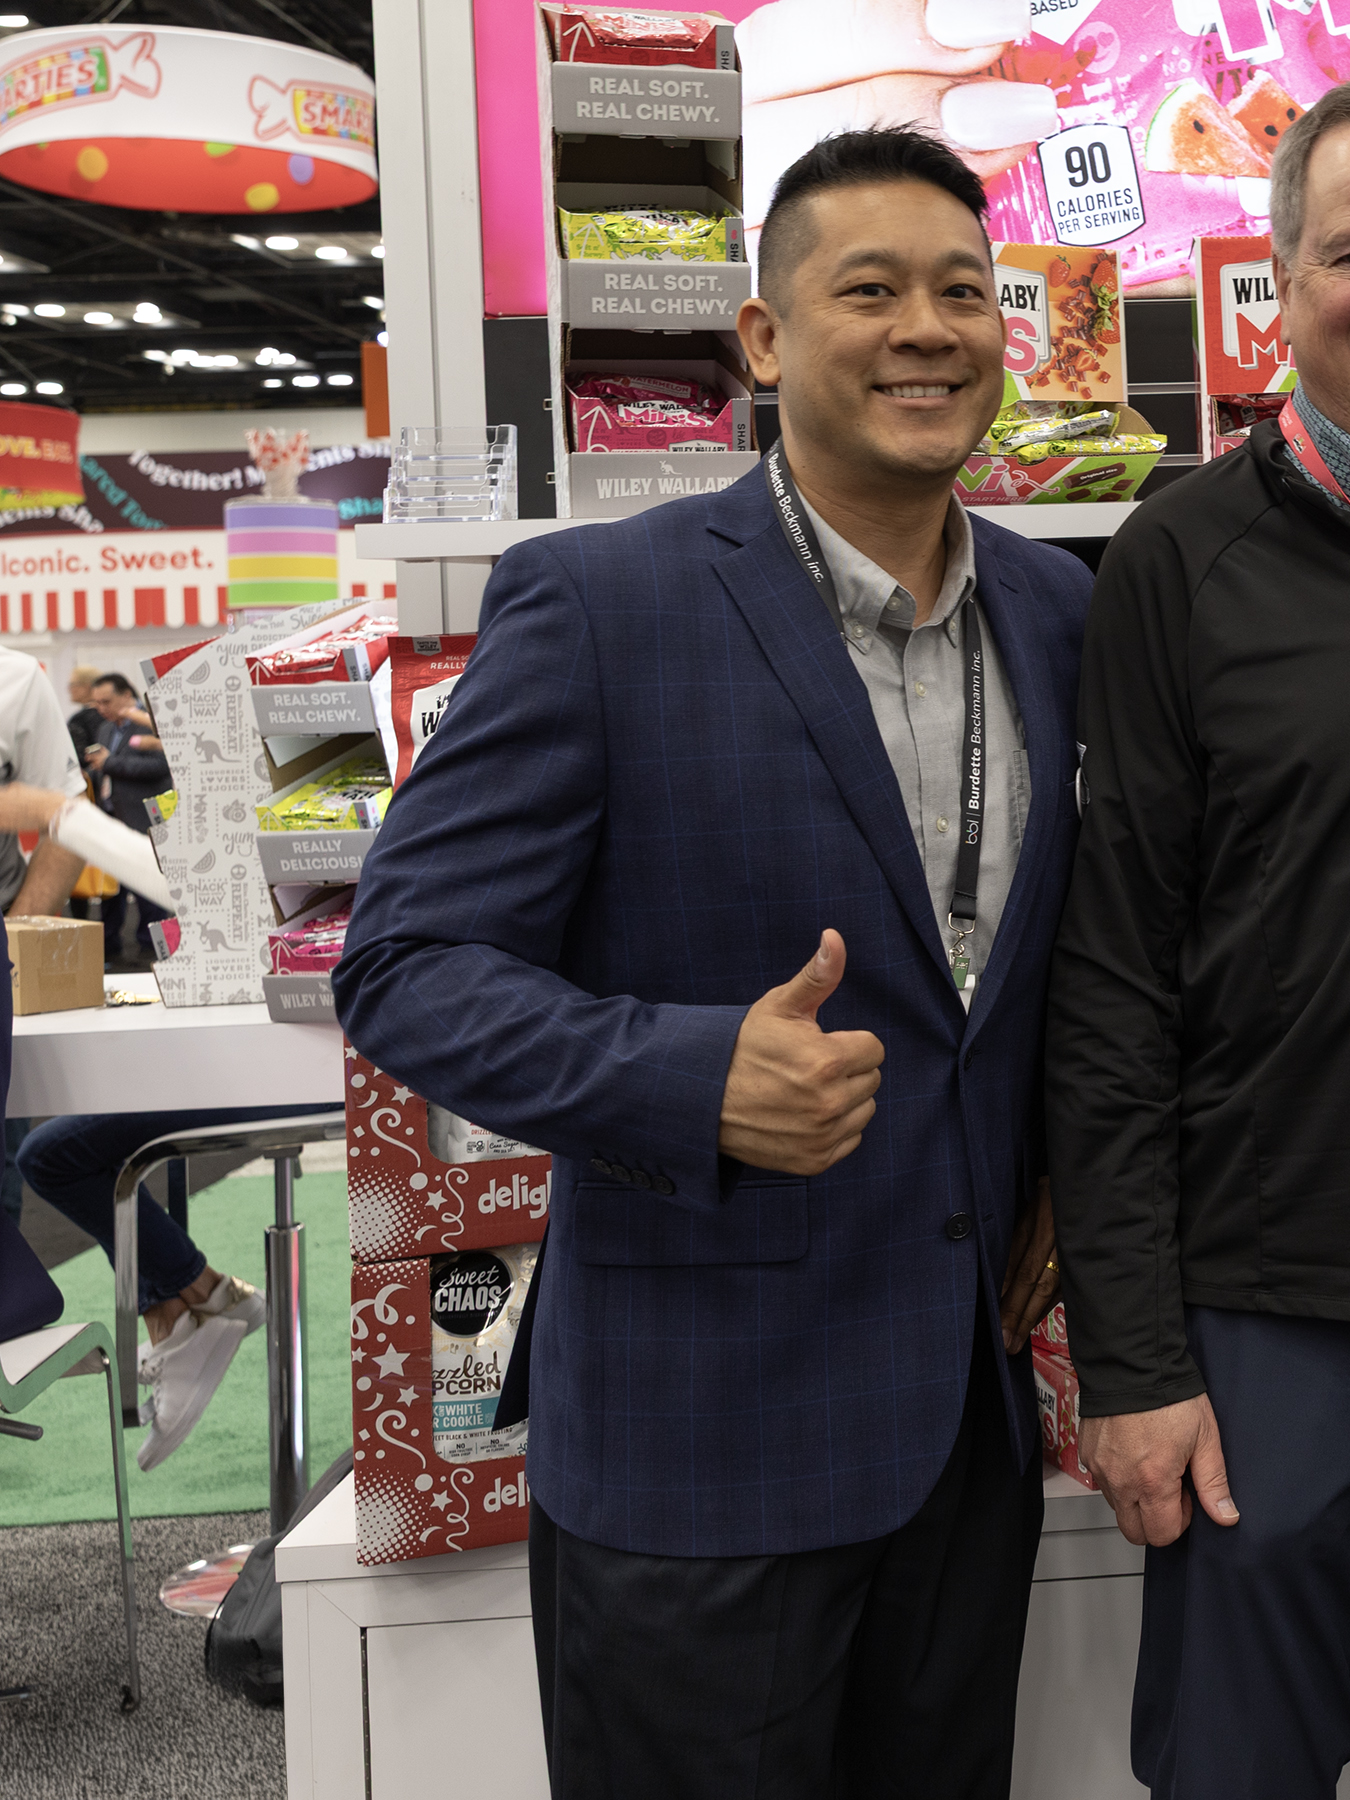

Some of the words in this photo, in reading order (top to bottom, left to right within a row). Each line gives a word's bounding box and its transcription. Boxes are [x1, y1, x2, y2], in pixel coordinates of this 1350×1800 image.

[0, 59, 97, 112] ARTIES
[589, 77, 645, 96] REAL
[649, 80, 710, 99] SOFT.
[577, 101, 632, 120] REAL
[636, 103, 720, 123] CHEWY.
[1064, 141, 1112, 188] 90
[1056, 188, 1134, 218] CALORIES
[1058, 217, 1081, 235] PER
[1084, 206, 1141, 231] SERVING
[605, 273, 660, 290] REAL
[663, 274, 724, 292] SOFT.
[592, 297, 647, 314] REAL
[650, 298, 734, 316] CHEWY.
[998, 283, 1039, 312] ABY
[1235, 312, 1294, 369] M
[630, 376, 689, 393] WATERMELON
[1079, 470, 1105, 482] Original
[596, 478, 653, 500] WILEY
[767, 452, 786, 498] Burdette
[778, 494, 813, 560] Beckmann
[806, 560, 825, 583] inc.
[1, 548, 91, 578] Iconic.
[100, 545, 215, 573] Sweet.
[217, 642, 249, 667] yum
[430, 661, 466, 670] REALLY
[971, 649, 981, 678] inc.
[273, 693, 310, 707] REAL
[310, 691, 351, 705] SOFT.
[193, 707, 221, 718] WAY
[268, 711, 305, 724] REAL
[305, 708, 361, 723] CHEWY.
[970, 678, 982, 745] Beckmann
[200, 784, 246, 792] REJOICE
[968, 746, 982, 810] Burdette
[222, 832, 256, 855] yum
[291, 839, 343, 854] REALLY
[198, 896, 224, 907] WAY
[206, 973, 251, 981] REJOICE
[279, 993, 317, 1009] WILEY
[439, 1264, 500, 1289] Sweet
[433, 1285, 502, 1313] CHAOS
[445, 1402, 483, 1417] WHITE
[442, 1414, 484, 1428] COOKIE
